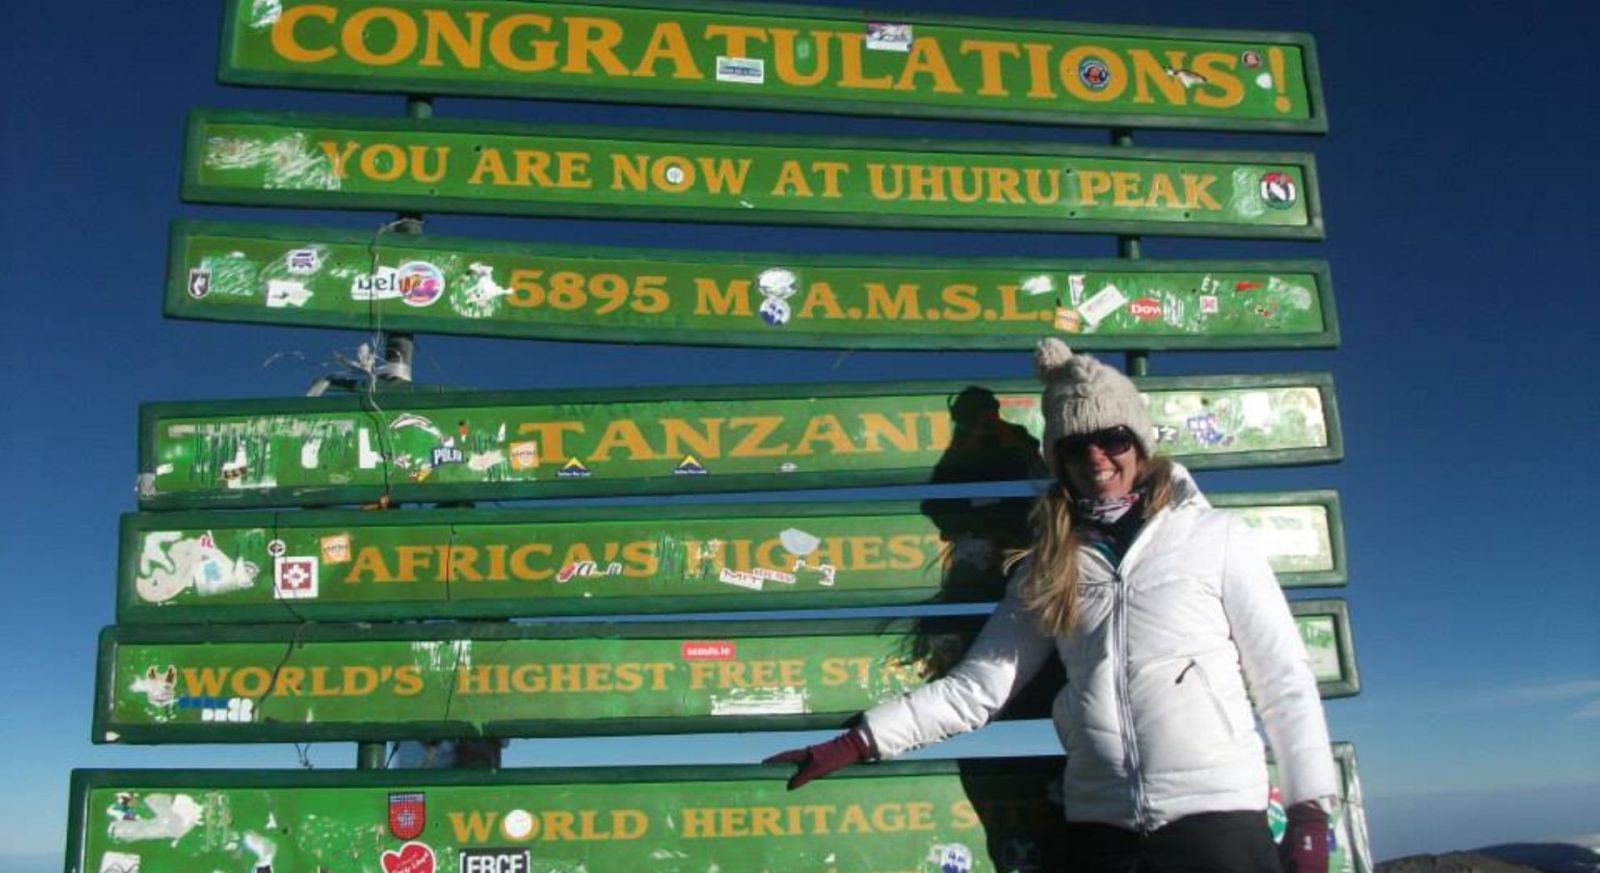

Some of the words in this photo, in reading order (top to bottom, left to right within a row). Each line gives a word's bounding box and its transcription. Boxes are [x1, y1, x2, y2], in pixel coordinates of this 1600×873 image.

[320, 140, 448, 184] YOU
[469, 149, 590, 188] ARE
[612, 154, 750, 195] NOW
[773, 161, 849, 198] AT
[868, 163, 1060, 205] UHURU
[1078, 170, 1221, 211] PEAK
[506, 268, 670, 314] 5895
[344, 541, 659, 584] AFRICA'S
[182, 664, 424, 698] WORLD'S
[456, 662, 675, 695] HIGHEST
[688, 658, 806, 690] FREE
[450, 809, 650, 843] WORLD
[682, 802, 936, 839] HERITAGE
